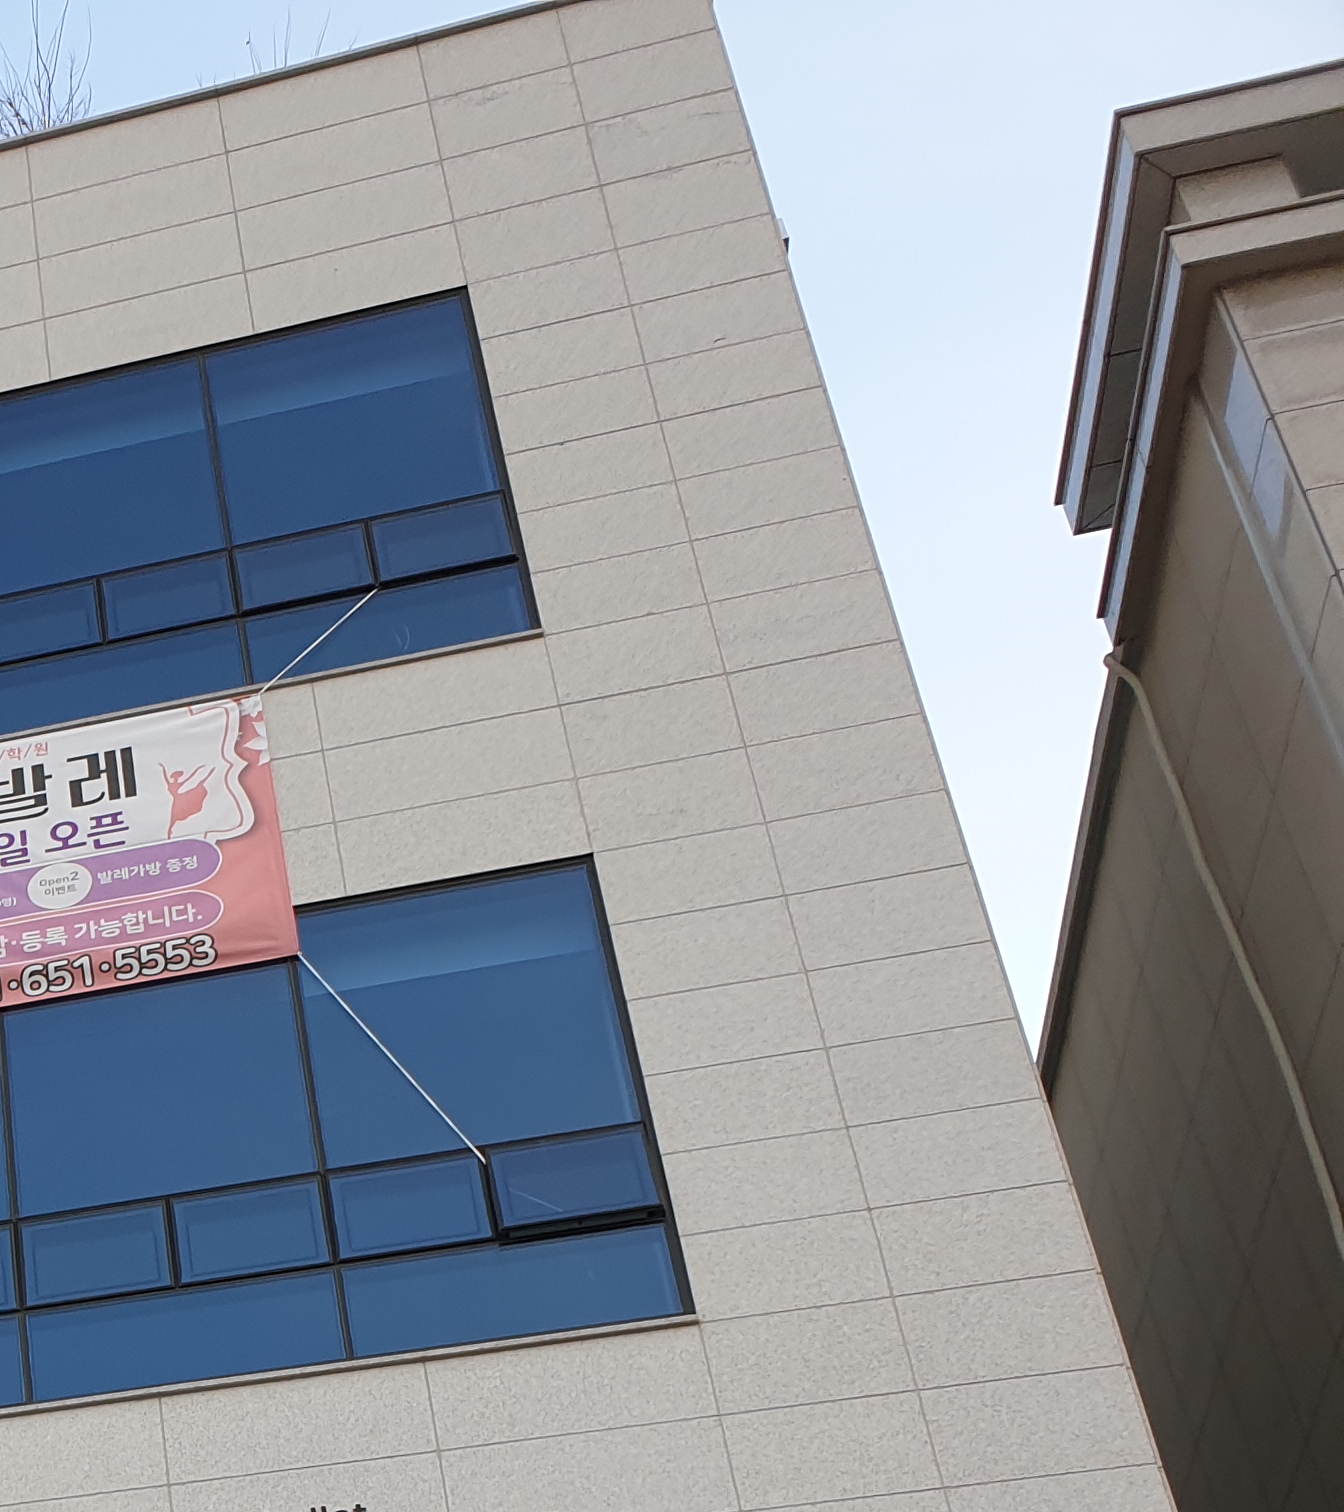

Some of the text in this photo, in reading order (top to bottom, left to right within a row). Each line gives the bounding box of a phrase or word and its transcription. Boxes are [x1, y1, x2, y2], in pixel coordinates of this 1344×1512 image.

[45, 811, 130, 853] 오픈
[97, 855, 199, 885] 발레가방 증정
[44, 884, 77, 896] 이벤트
[74, 903, 203, 940] 가능합니다.
